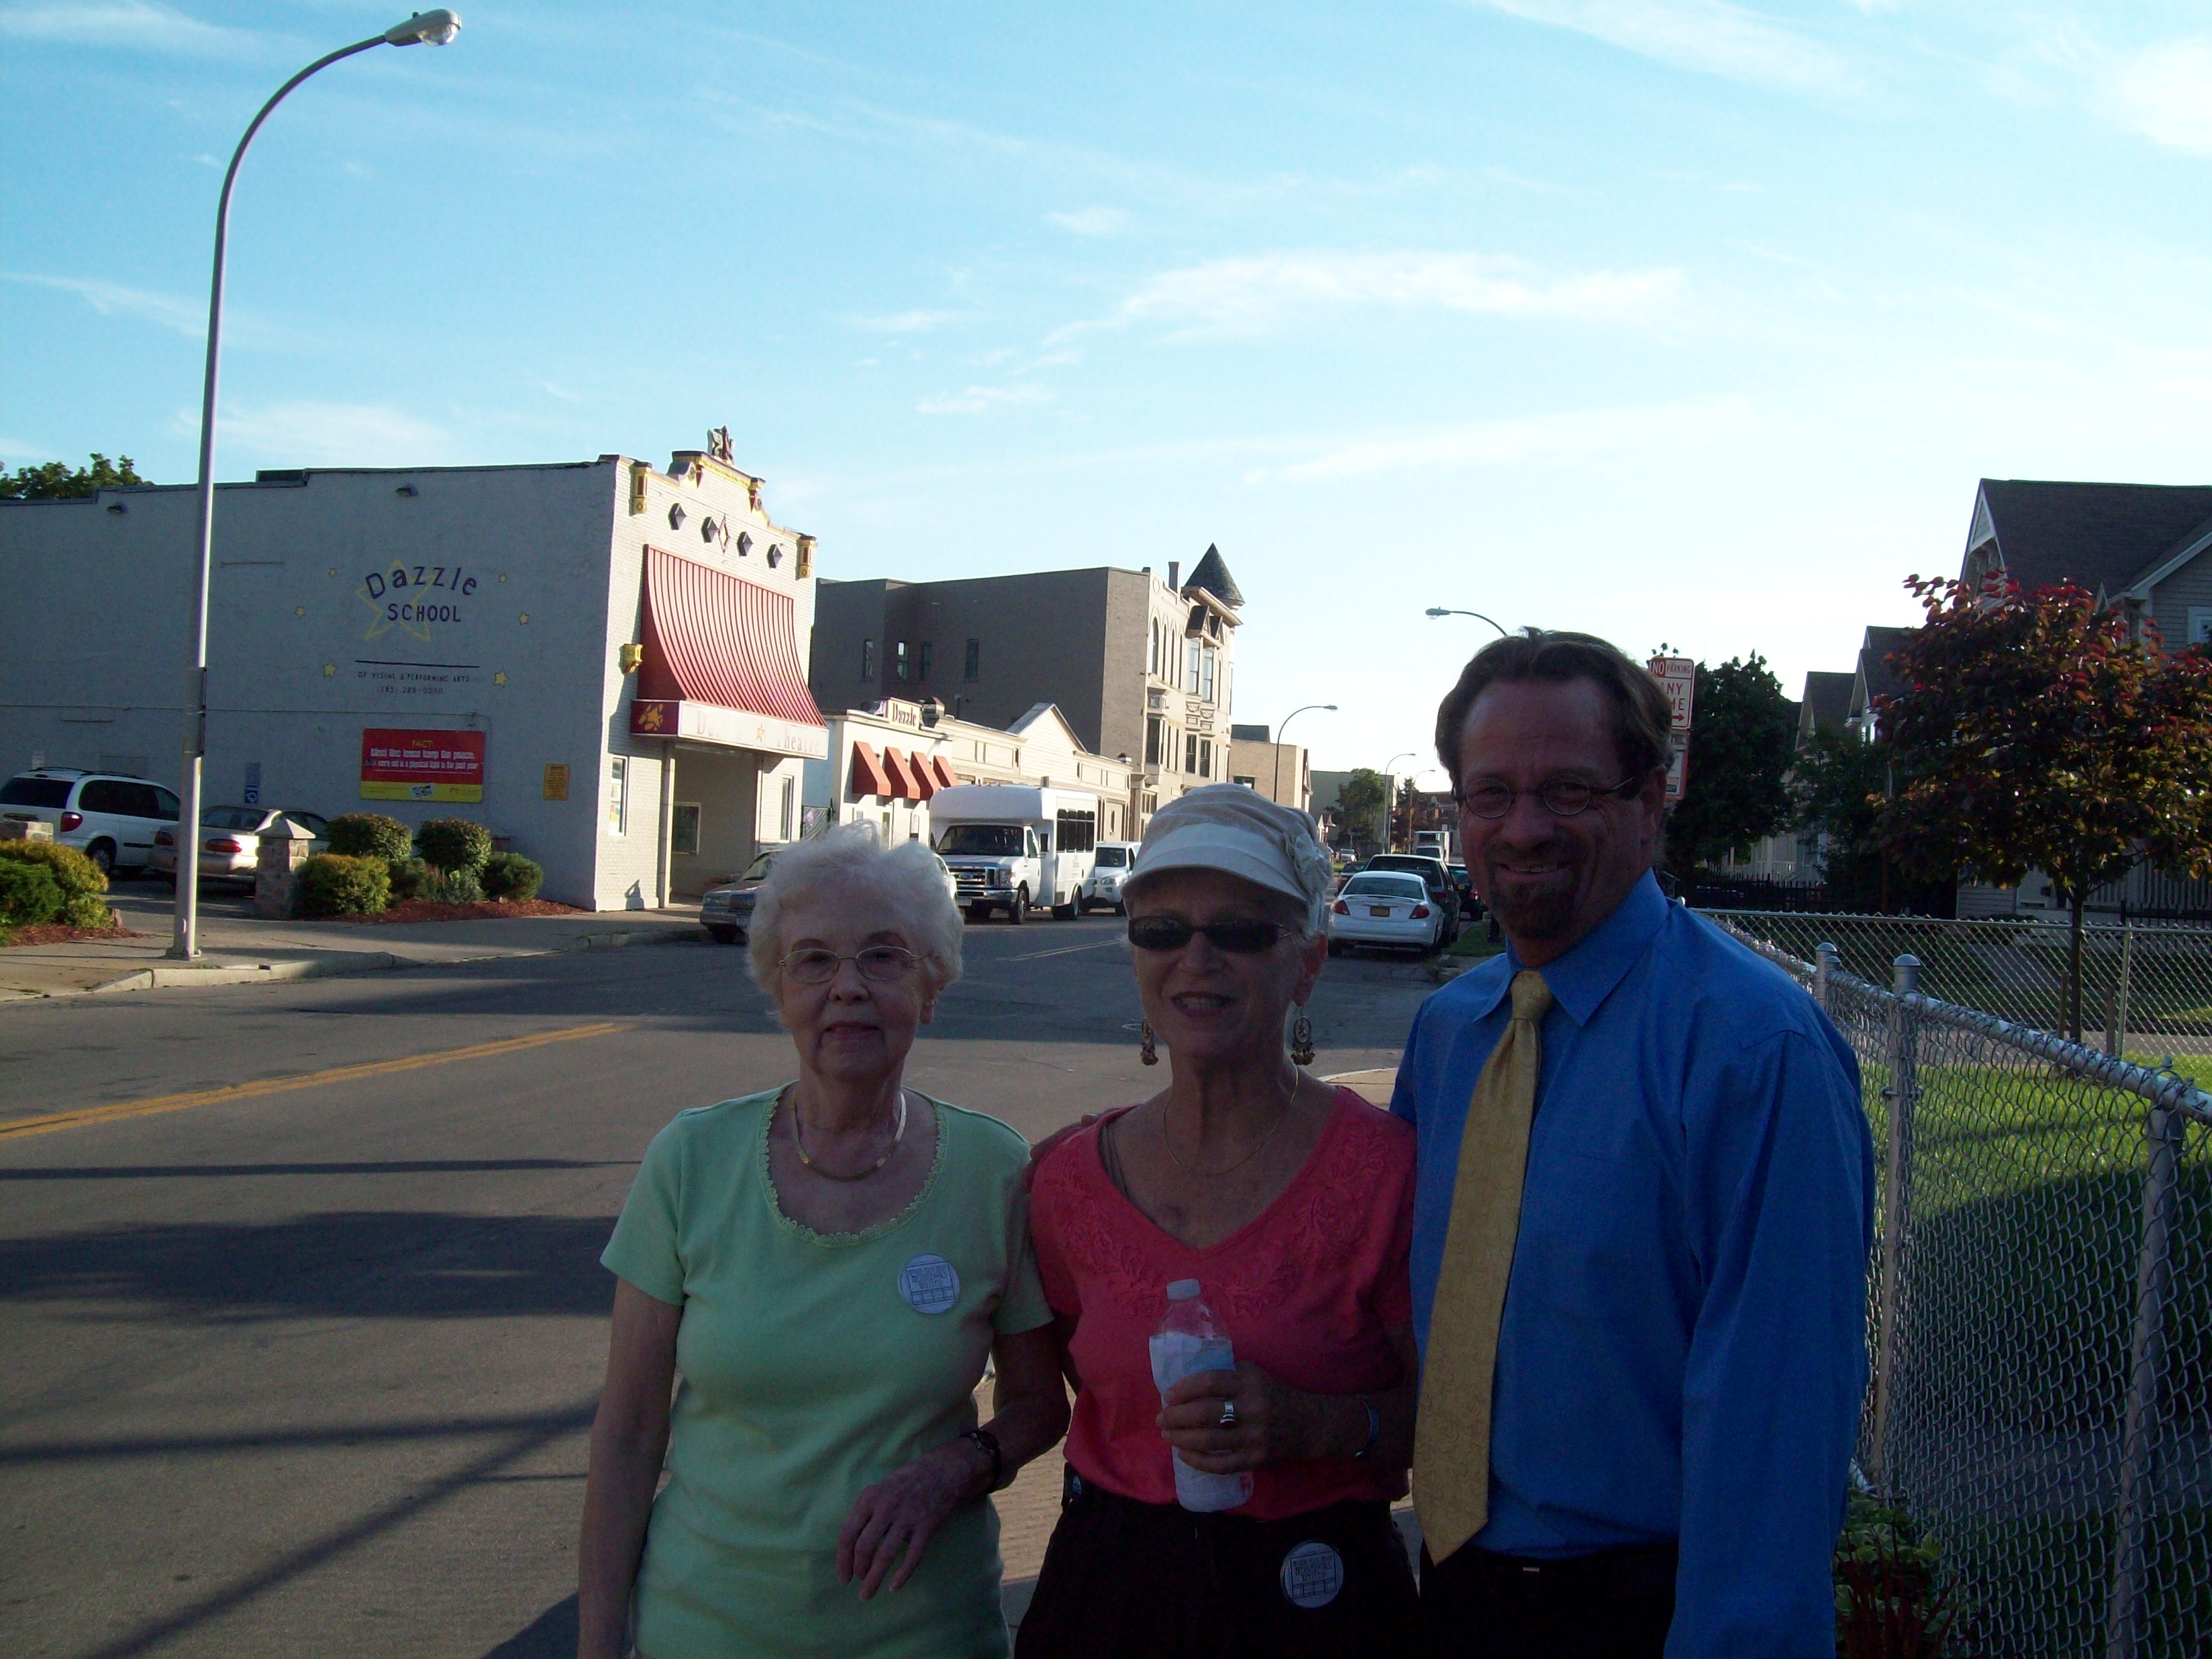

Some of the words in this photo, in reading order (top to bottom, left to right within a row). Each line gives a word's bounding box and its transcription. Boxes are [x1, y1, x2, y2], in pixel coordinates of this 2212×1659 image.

[364, 566, 477, 599] Dazzle
[387, 603, 461, 622] SCHOOL
[1652, 661, 1665, 674] NO
[1666, 664, 1691, 674] PARKING
[372, 672, 396, 680] VISUAL
[407, 673, 449, 683] PERFORMING
[452, 674, 470, 683] ARTS
[1660, 682, 1683, 696] NY
[892, 703, 917, 727] Dazzle
